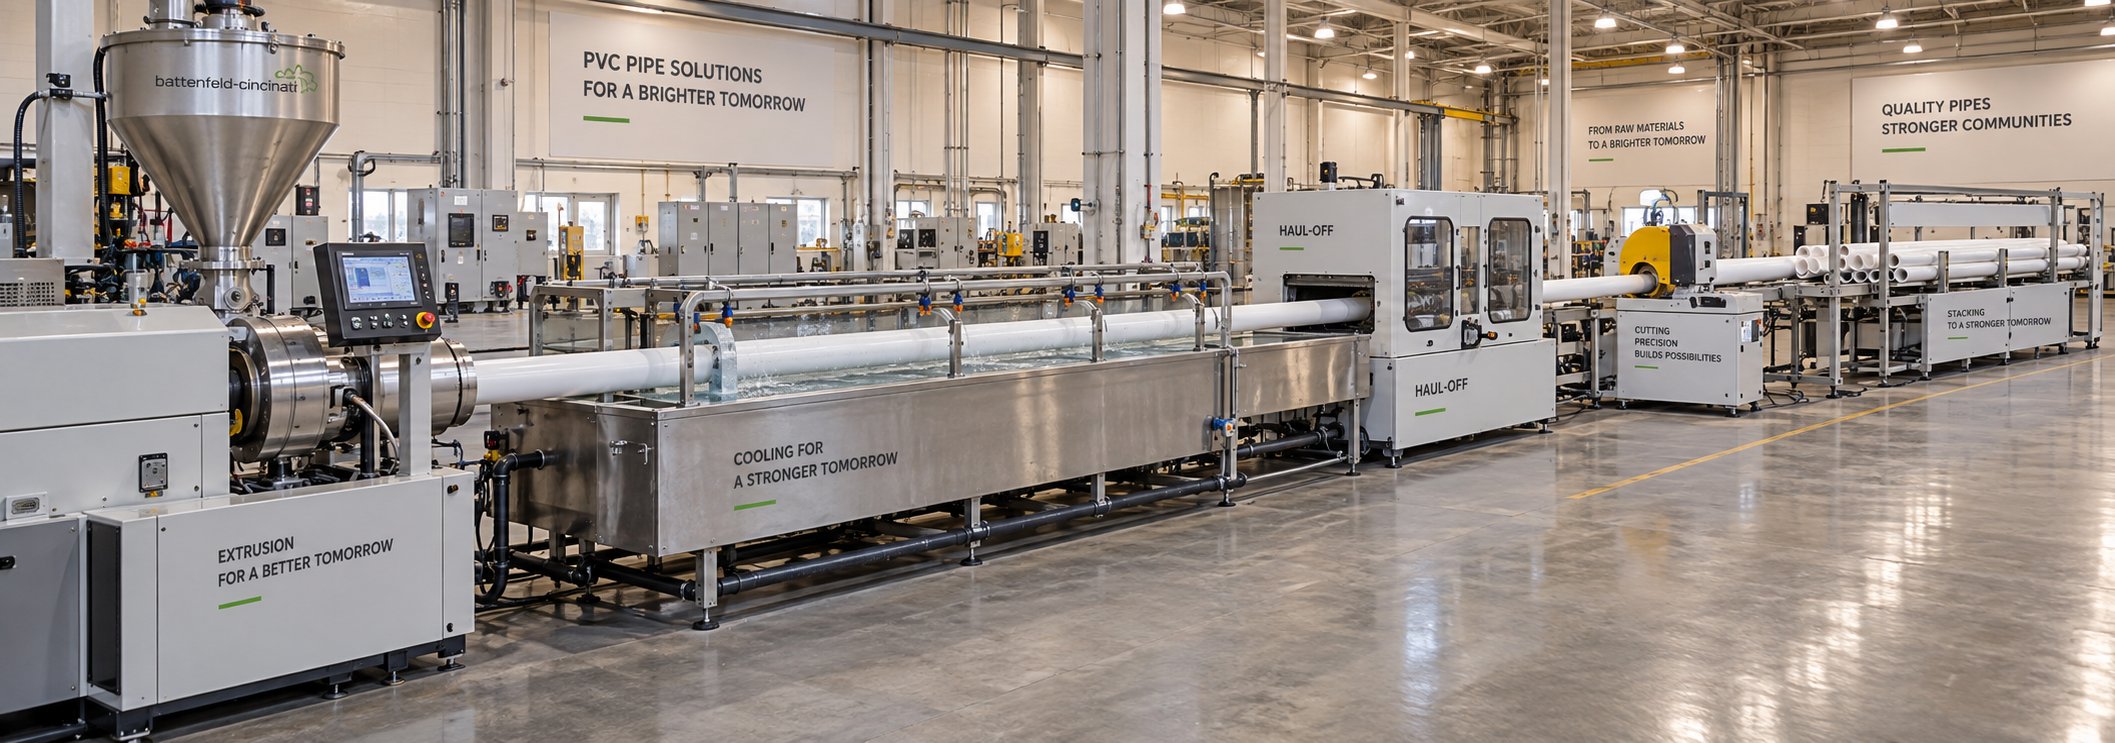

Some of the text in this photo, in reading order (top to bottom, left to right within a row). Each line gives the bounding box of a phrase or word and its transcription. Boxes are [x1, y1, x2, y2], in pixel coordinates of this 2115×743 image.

[583, 51, 763, 84] PVC PIPE SOLUTIONS
[583, 80, 806, 112] FOR A BRIGHTER TOMORROW
[1882, 97, 1991, 117] QUALITY PIPES
[1588, 121, 1685, 135] FROM RAW MATERIALS
[1882, 113, 2072, 135] STRONGER COMMUNITIES
[1588, 135, 1706, 150] TO A BRIGHTER TOMORROW
[1279, 224, 1334, 236] HAUL-OFF
[1947, 308, 1985, 318] STACKING
[1634, 326, 1670, 335] CUTTING
[1947, 317, 2052, 330] TO A STRONGER TOMORROW
[1634, 338, 1678, 347] PRECISION
[1634, 350, 1722, 363] BUILDS POSSIBILITIES
[1415, 377, 1468, 398] HAUL-OFF
[733, 441, 824, 466] COOLING FOR
[733, 451, 898, 490] A STRONGER TOMORROW
[218, 536, 294, 564] EXTRUSION
[218, 538, 394, 587] FOR A BETTER TOMORROW
